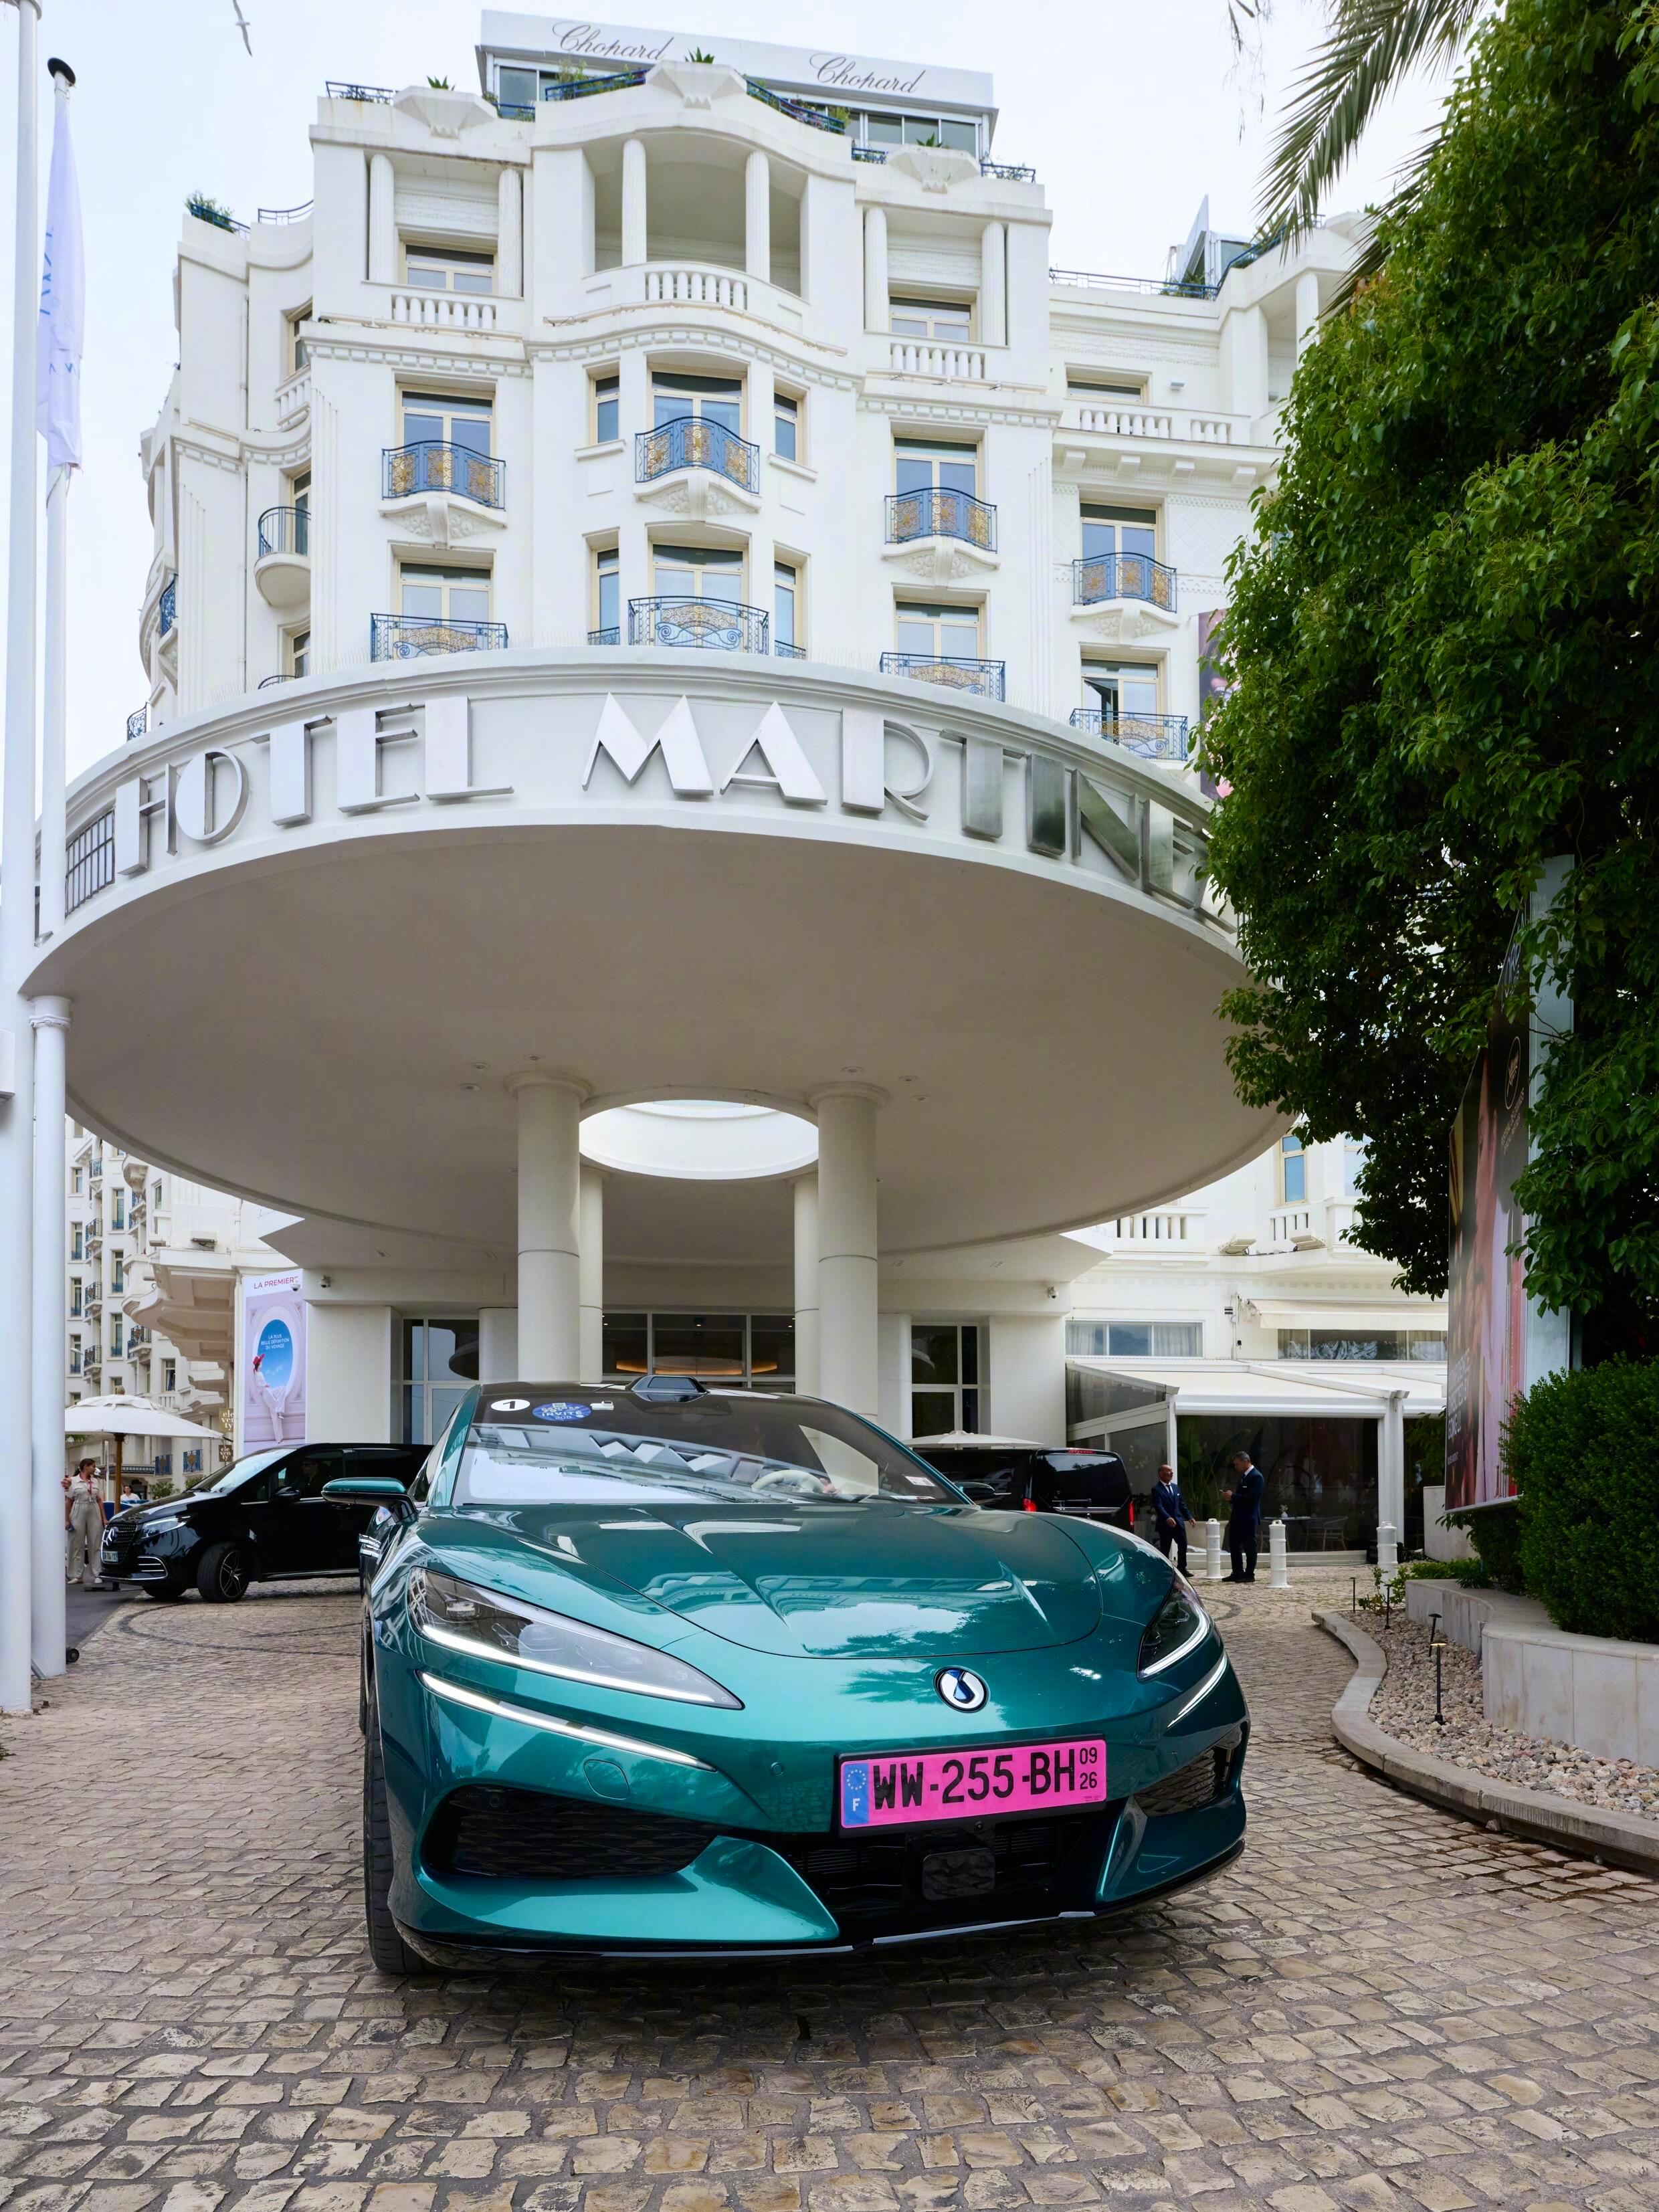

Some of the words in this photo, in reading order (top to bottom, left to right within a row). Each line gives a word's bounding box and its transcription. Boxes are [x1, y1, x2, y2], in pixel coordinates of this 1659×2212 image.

[553, 21, 674, 61] Chopard
[809, 53, 926, 94] Chopard
[116, 696, 514, 876] HOTEL
[503, 1401, 516, 1409] 1
[873, 1748, 1075, 1810] WW-255-BH
[1080, 1747, 1097, 1765] 09
[1080, 1771, 1097, 1790] 26
[852, 1798, 860, 1811] F
